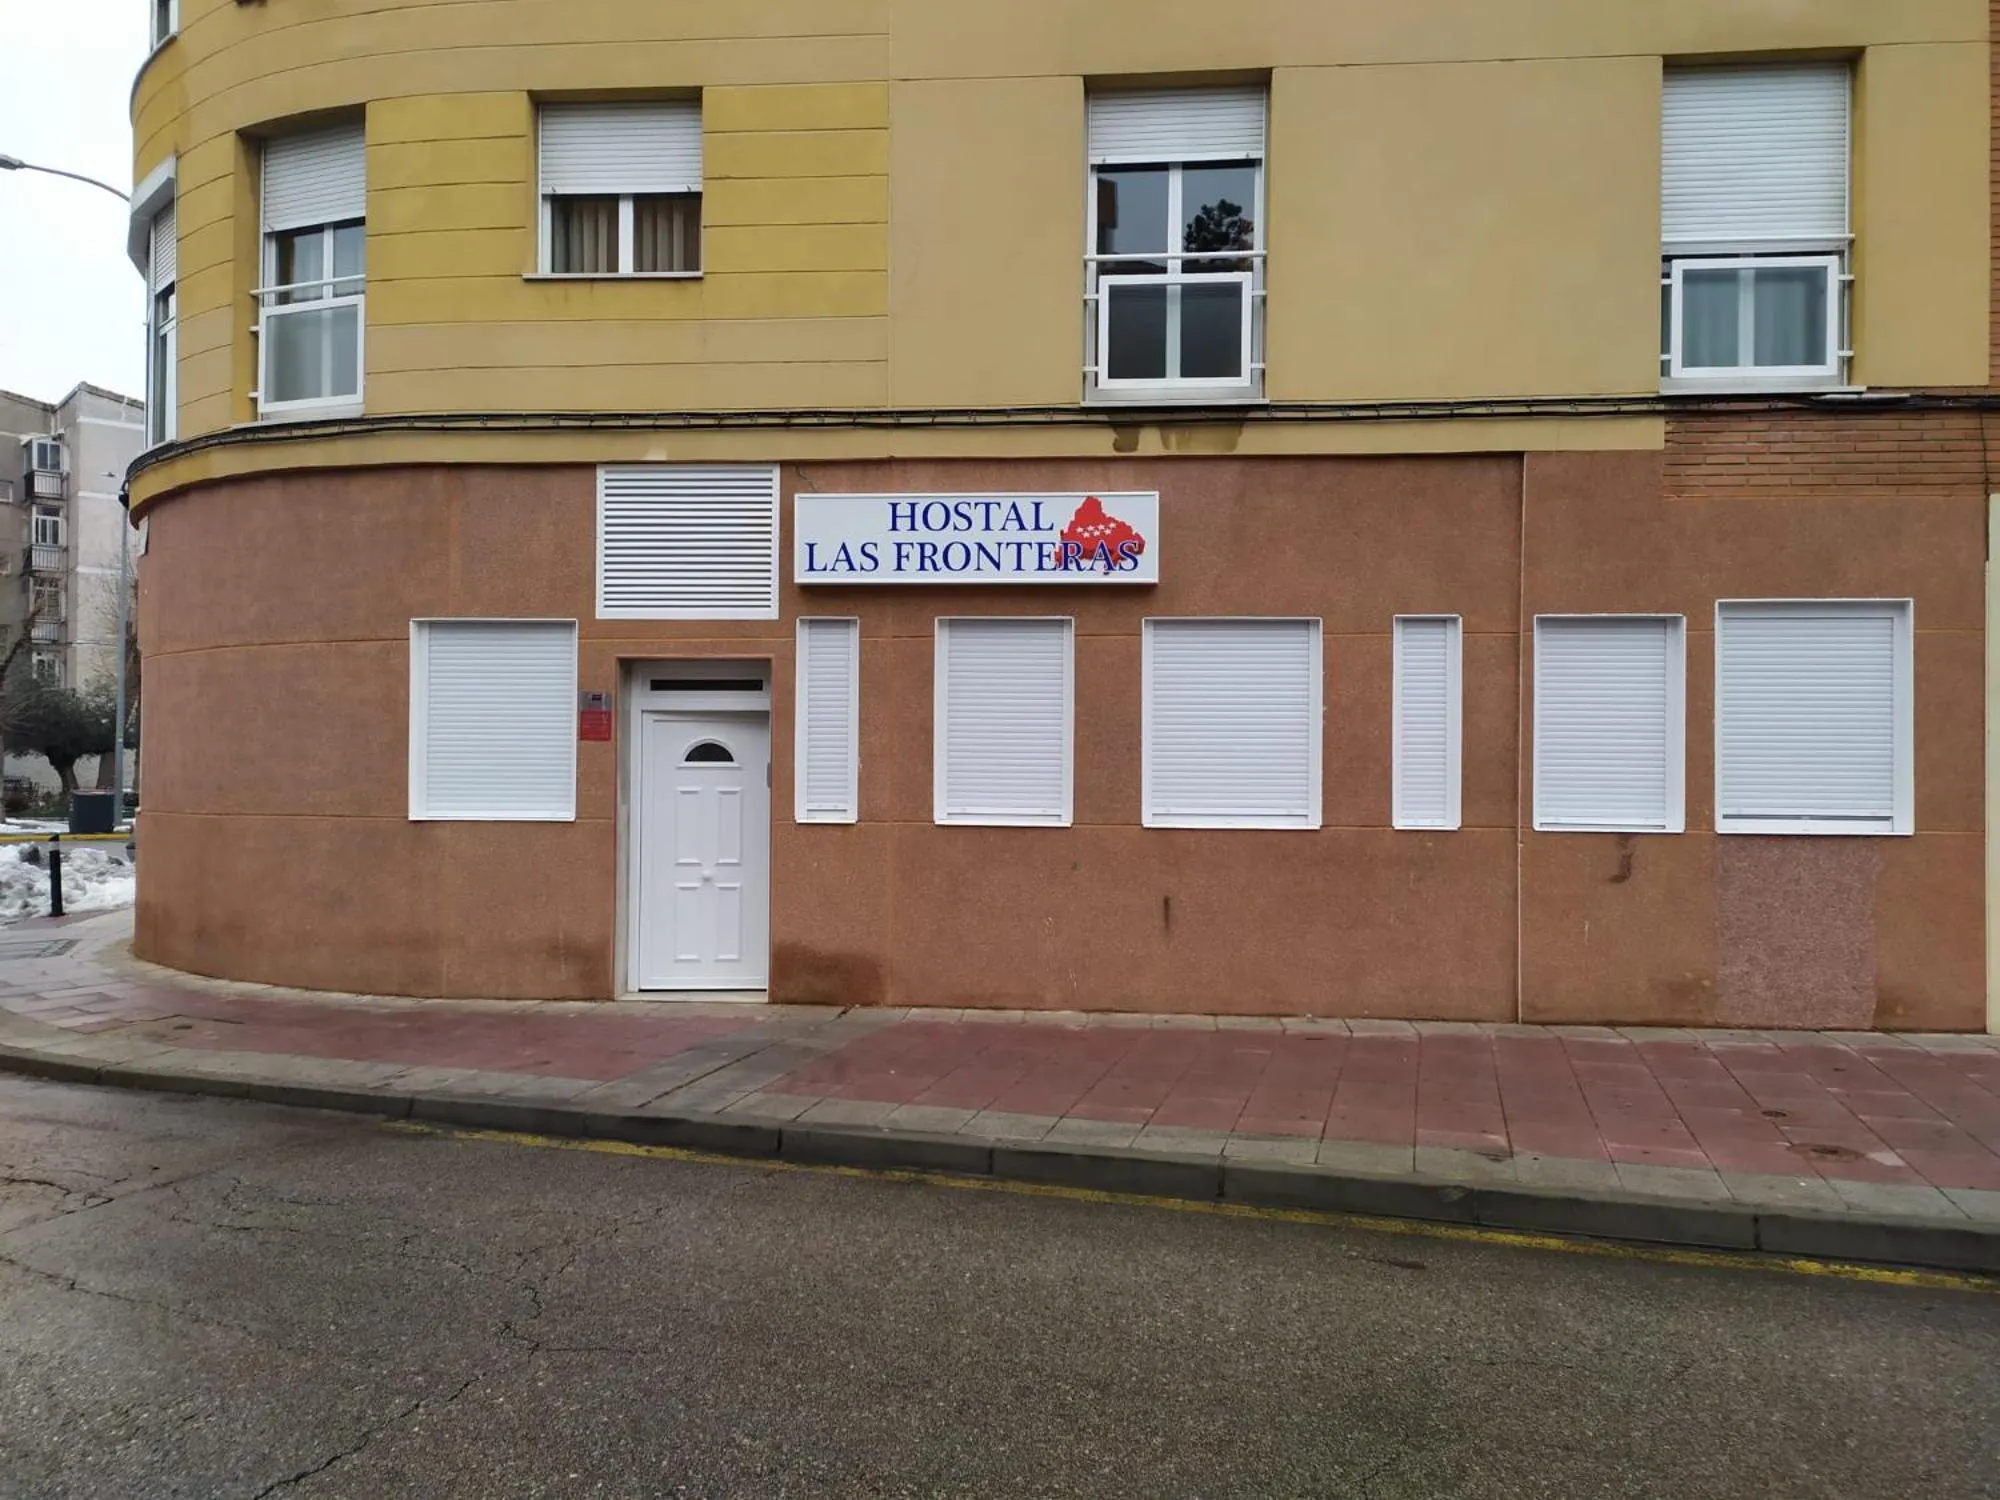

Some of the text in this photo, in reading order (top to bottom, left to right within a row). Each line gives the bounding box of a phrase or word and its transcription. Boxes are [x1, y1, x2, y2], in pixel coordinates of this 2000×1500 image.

[887, 501, 1054, 532] HOSTAL
[804, 541, 1139, 572] LAS FRONTERAS
